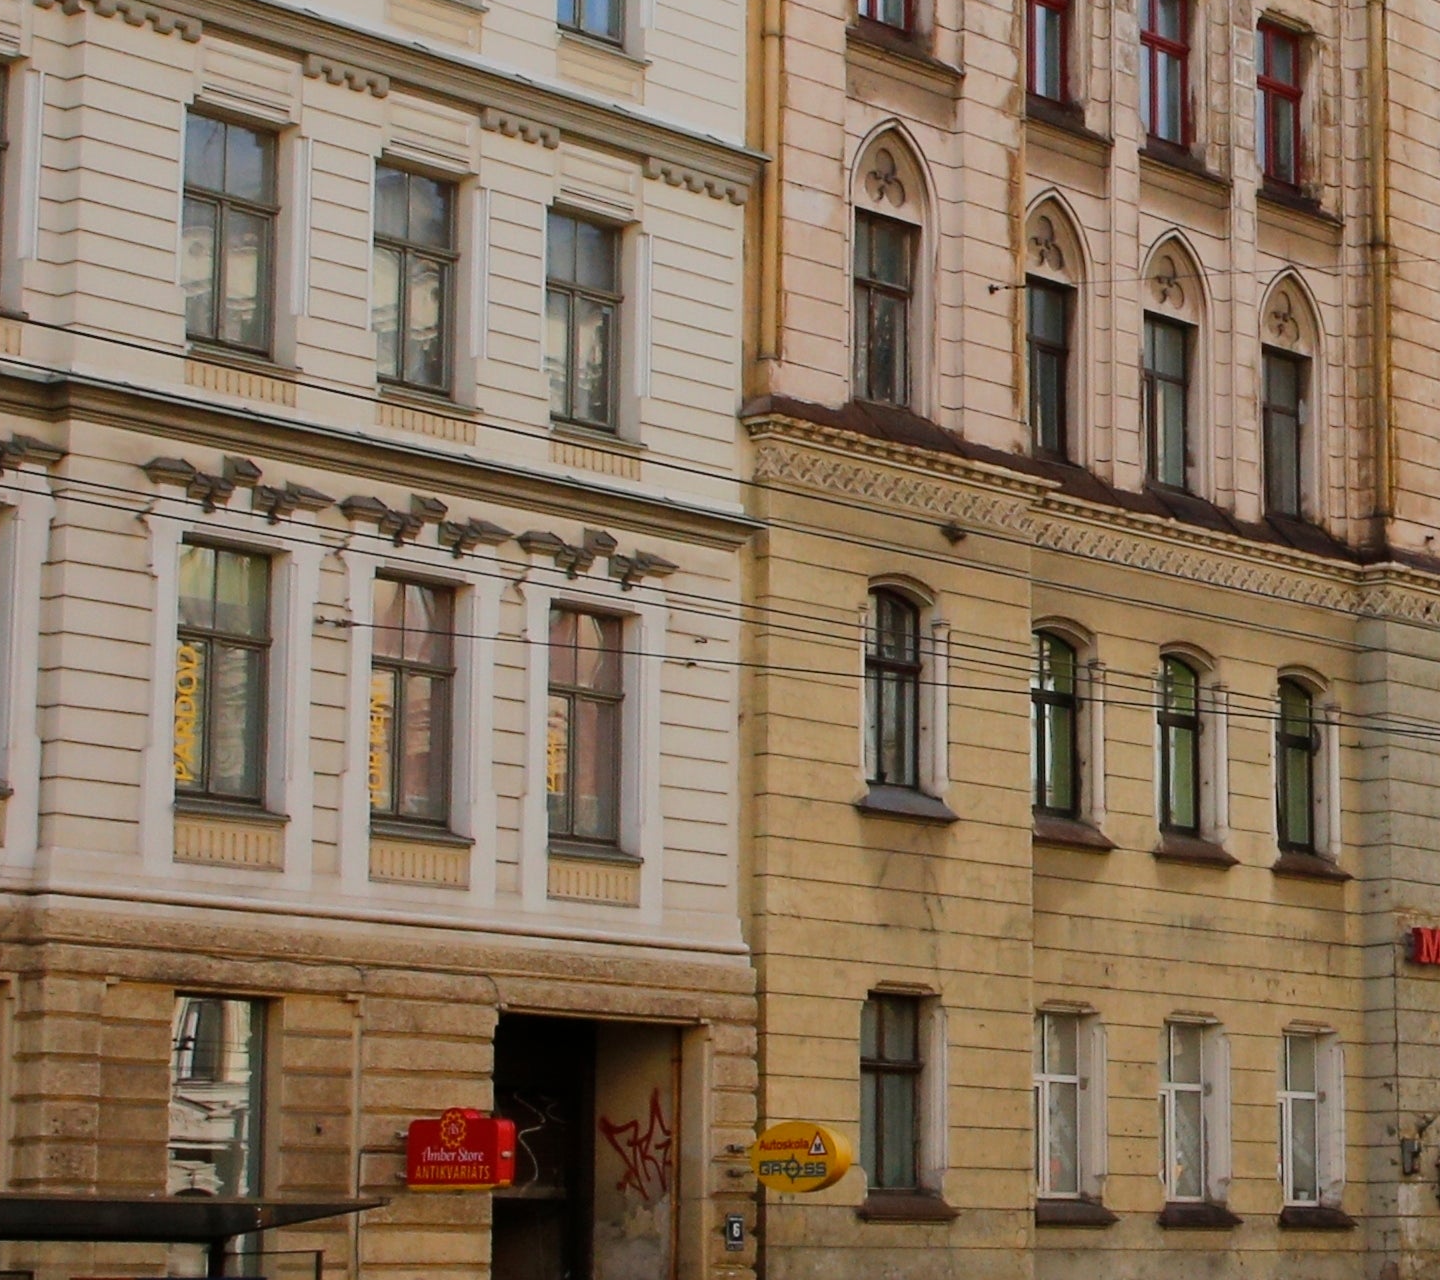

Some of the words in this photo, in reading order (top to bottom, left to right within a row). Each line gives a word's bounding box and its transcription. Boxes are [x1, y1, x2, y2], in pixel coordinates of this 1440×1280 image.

[174, 642, 198, 782] PARDOD
[759, 1139, 809, 1151] Autoskola
[421, 1149, 456, 1163] Amber
[458, 1148, 485, 1162] Store
[415, 1164, 490, 1180] ANTIKVARIĀTS
[732, 1223, 741, 1238] 6
